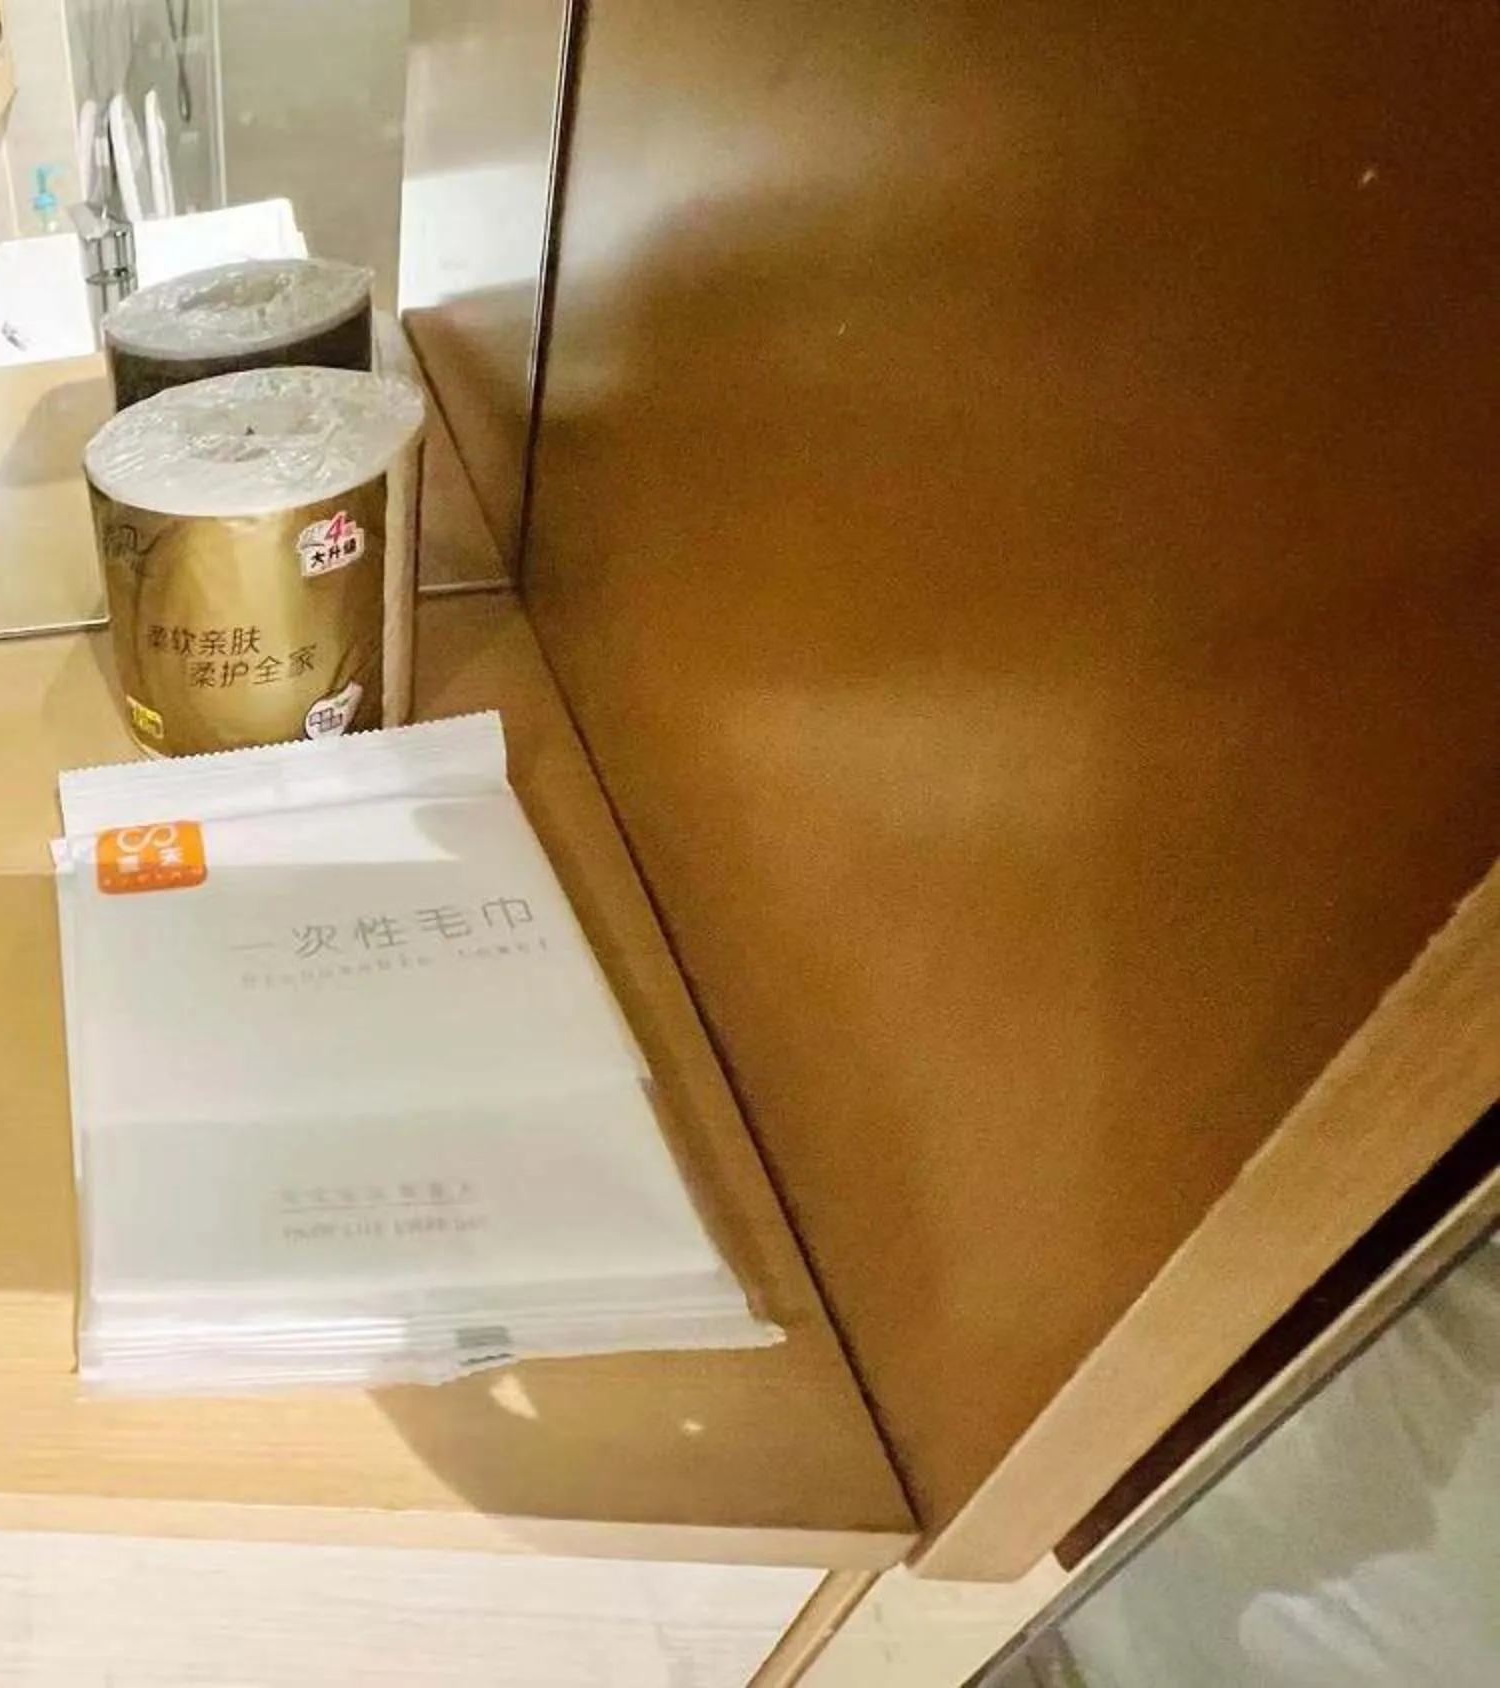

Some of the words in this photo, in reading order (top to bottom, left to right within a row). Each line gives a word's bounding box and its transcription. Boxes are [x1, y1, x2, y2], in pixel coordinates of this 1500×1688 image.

[148, 624, 260, 657] 柔软亲肤
[188, 643, 318, 688] 柔护全家
[226, 897, 534, 959] 一次性毛巾
